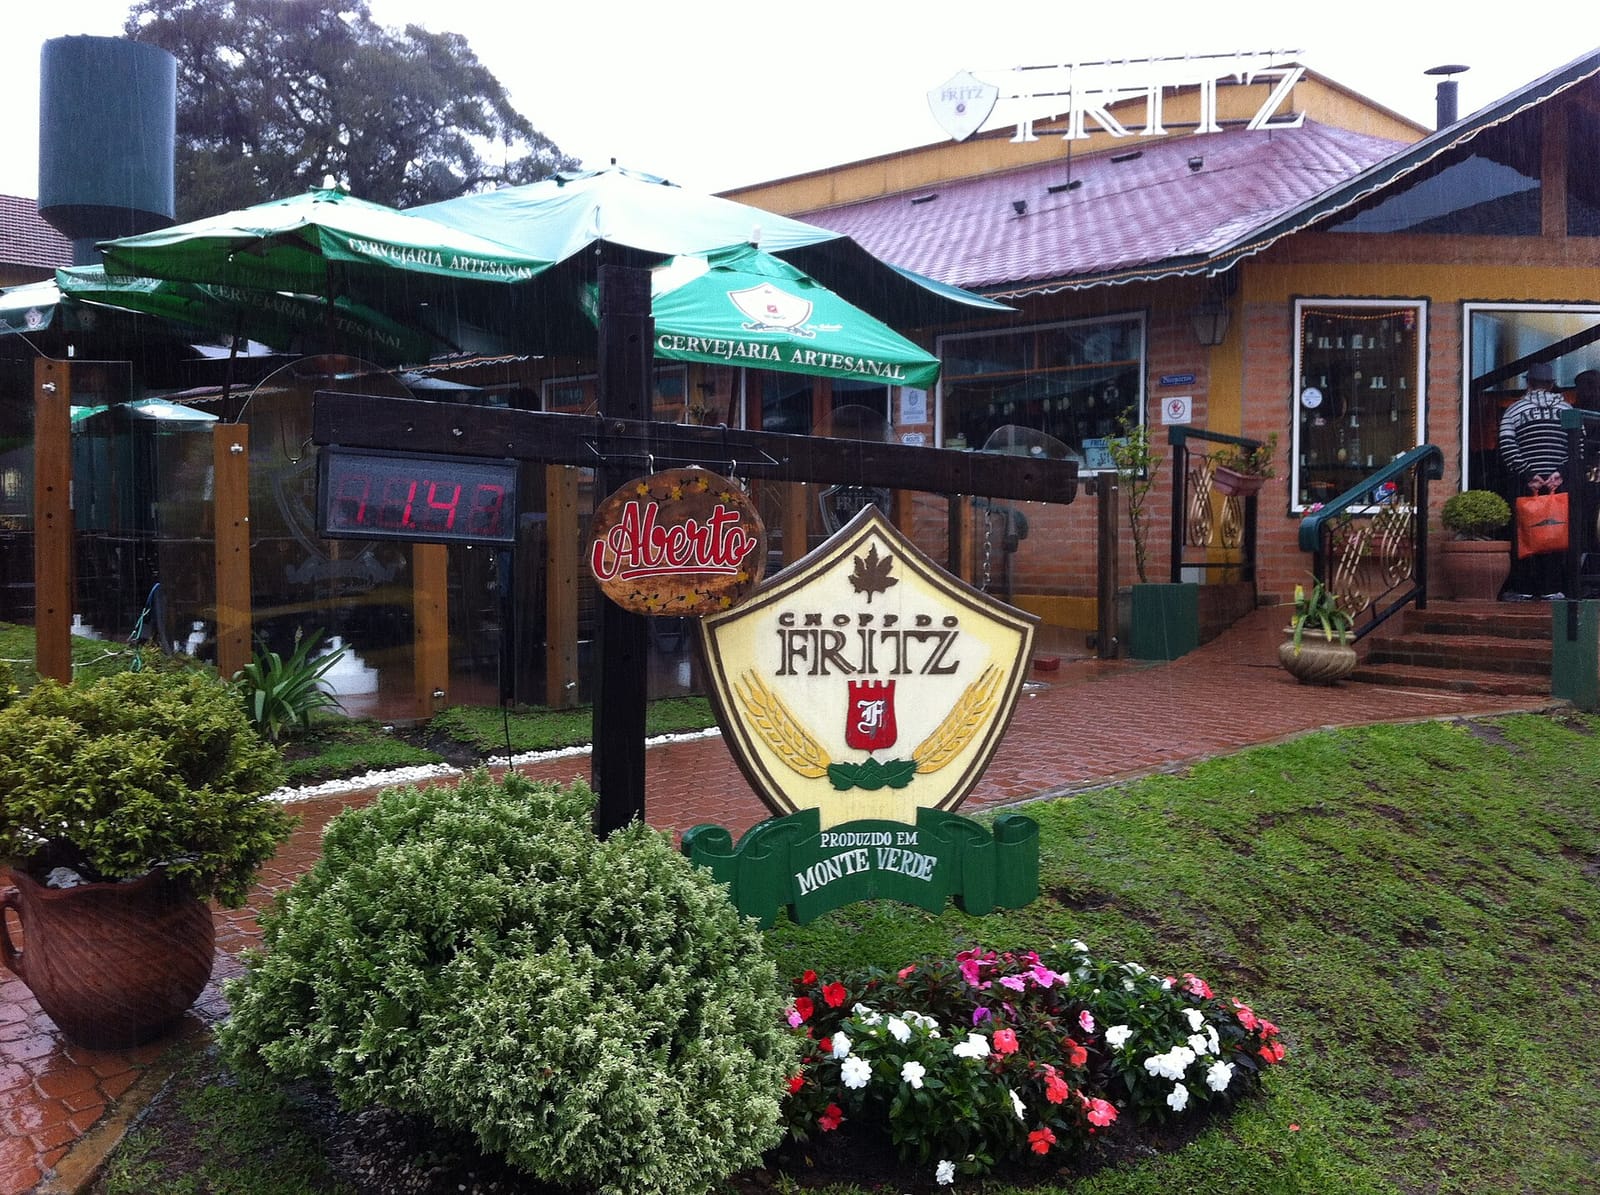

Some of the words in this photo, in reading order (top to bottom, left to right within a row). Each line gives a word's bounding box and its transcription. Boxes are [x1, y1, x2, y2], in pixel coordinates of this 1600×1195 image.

[348, 238, 444, 266] CERVEJARIA
[657, 334, 782, 362] CERVEJARIA
[790, 348, 906, 381] ARTESANAL
[592, 501, 757, 582] Aberto
[778, 612, 899, 628] CHOPP
[915, 614, 960, 628] DO
[774, 628, 961, 676] FRITZ
[819, 831, 893, 848] PRODUZIDO
[896, 831, 919, 846] EM
[795, 847, 871, 896] MONTE
[875, 847, 938, 882] VERDE
